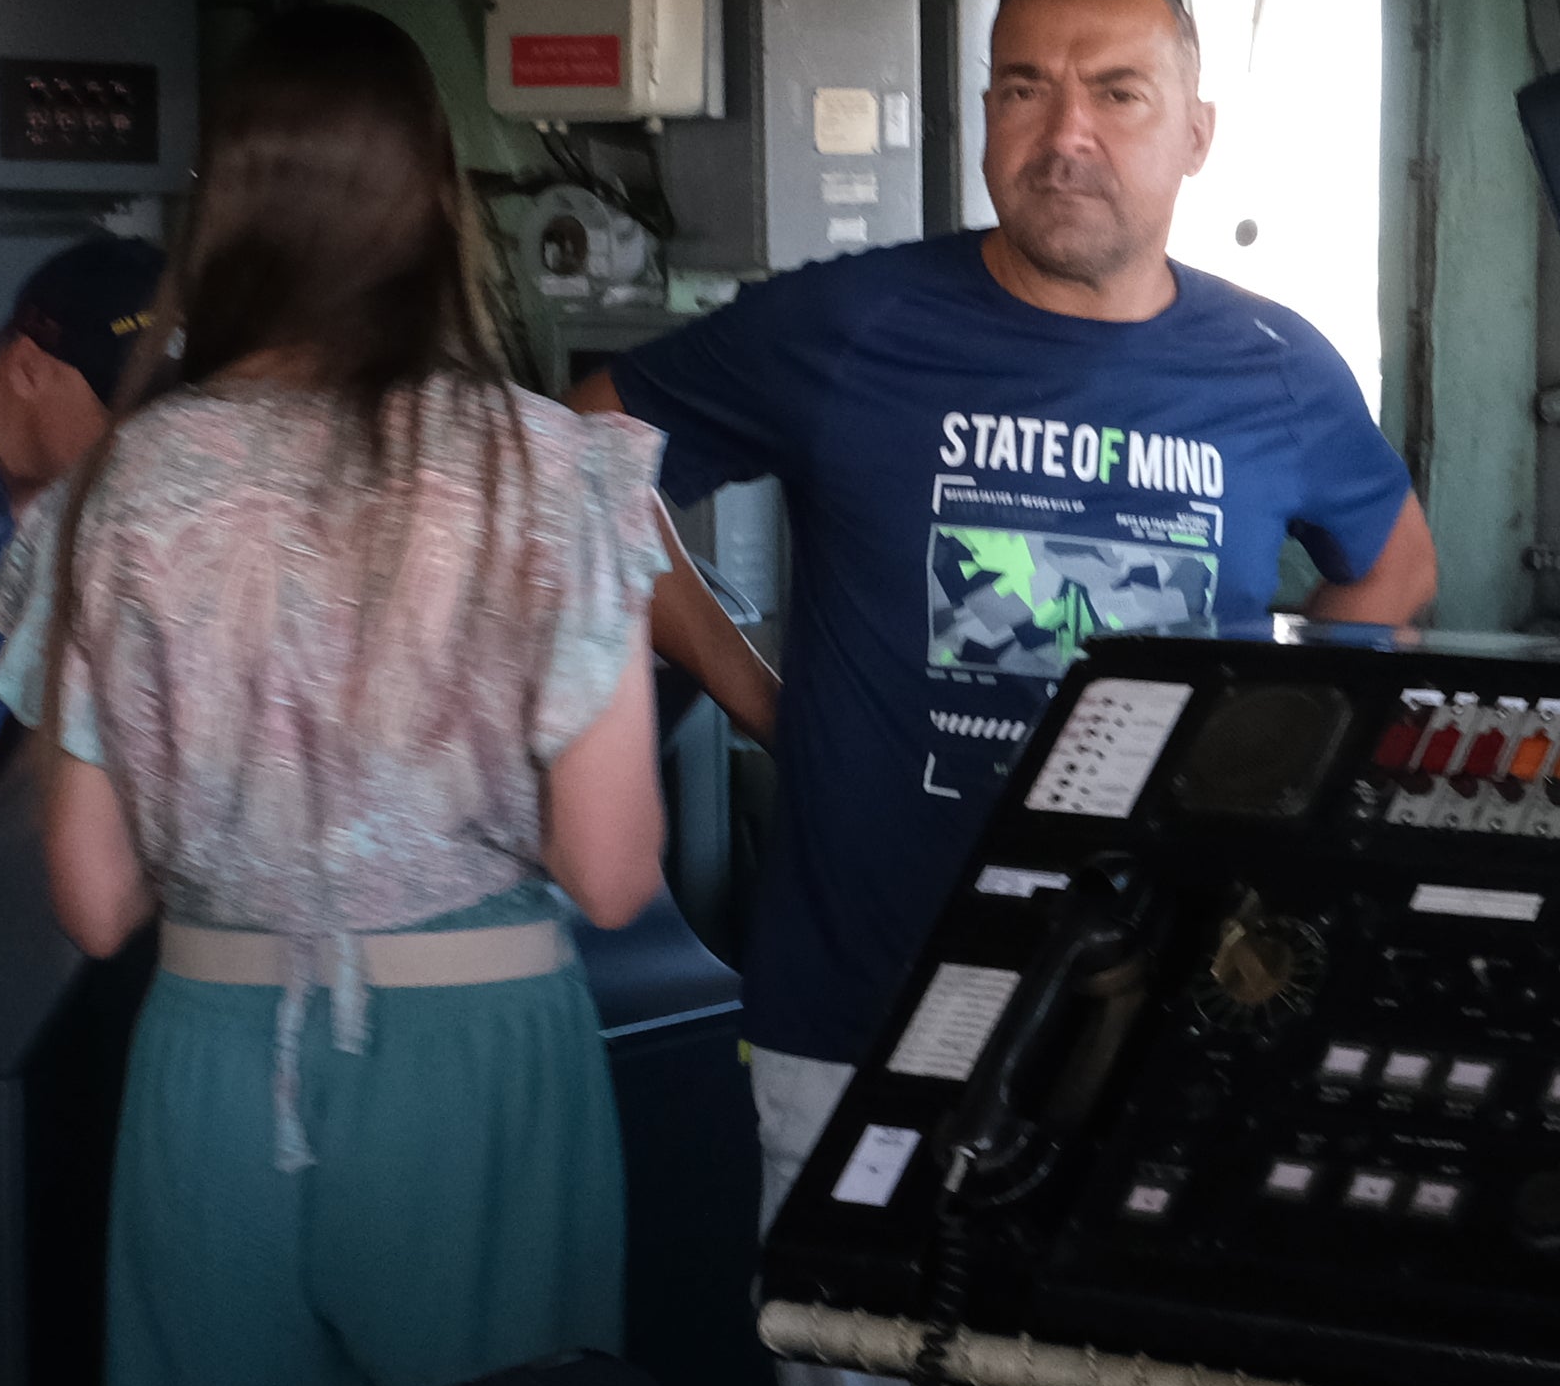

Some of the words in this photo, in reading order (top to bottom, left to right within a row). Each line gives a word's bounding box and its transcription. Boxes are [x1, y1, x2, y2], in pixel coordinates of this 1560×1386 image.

[939, 410, 1070, 479] STATE
[1071, 422, 1126, 485] OF
[1127, 429, 1225, 499] MIND
